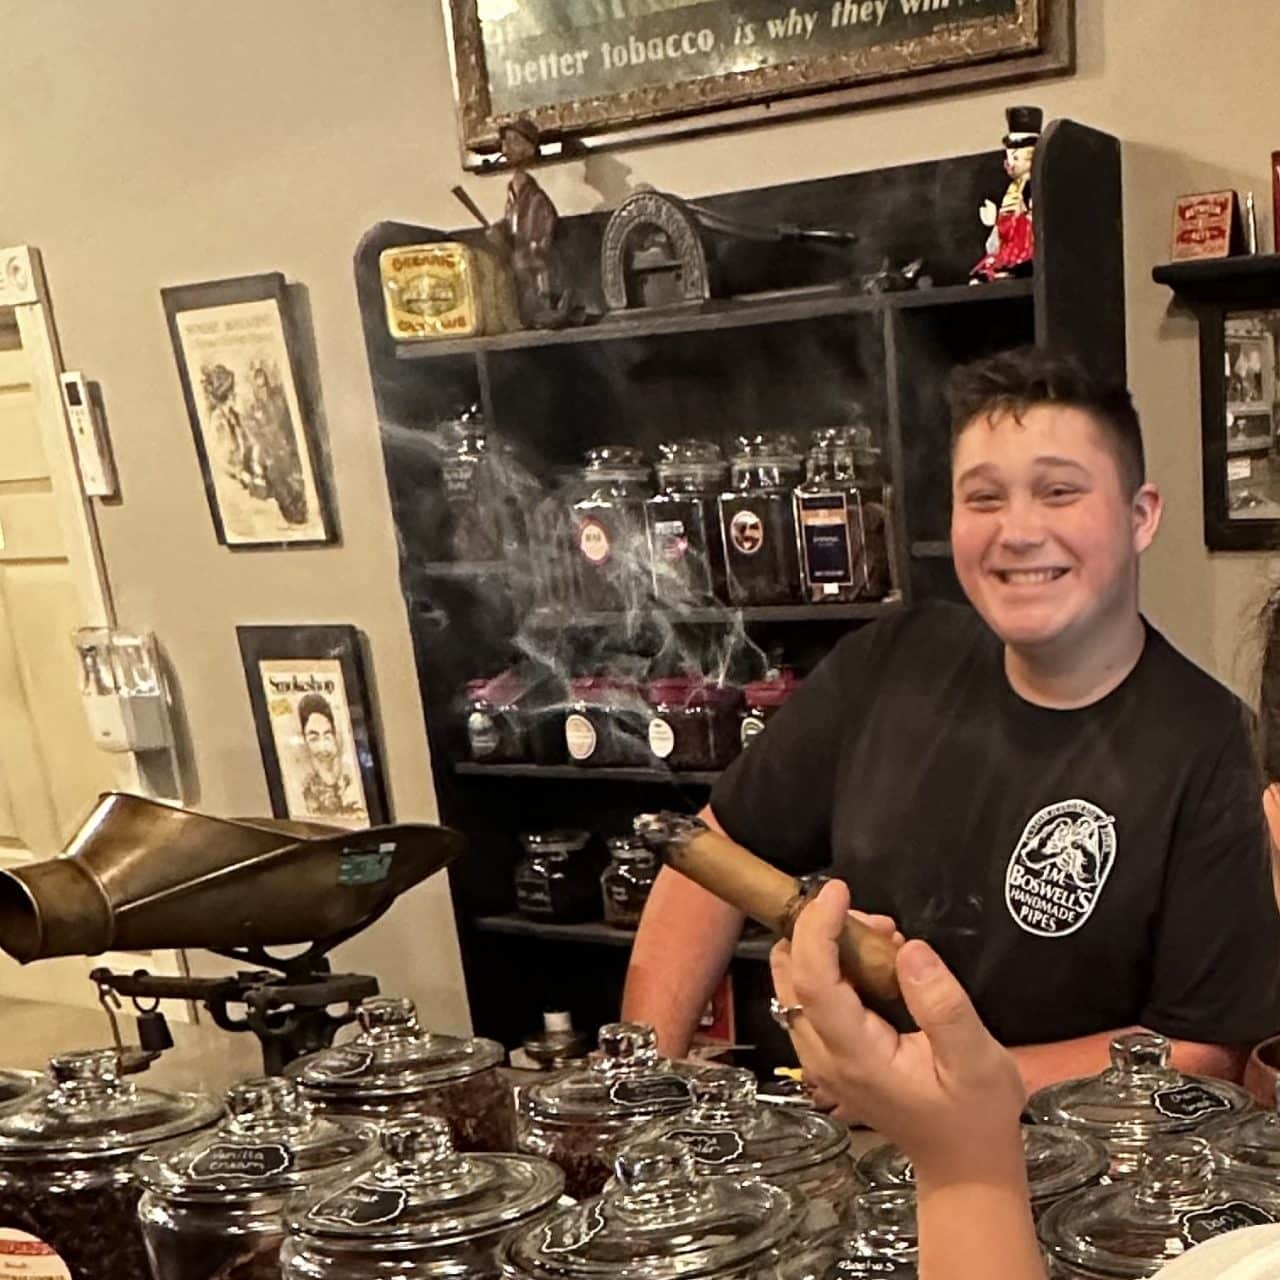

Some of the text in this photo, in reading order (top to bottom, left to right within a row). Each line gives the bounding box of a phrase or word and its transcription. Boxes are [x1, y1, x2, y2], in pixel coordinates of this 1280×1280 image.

[504, 49, 589, 88] better
[601, 28, 715, 69] tobacco
[734, 17, 756, 45] is
[767, 8, 818, 39] why
[832, 0, 888, 27] they
[1010, 863, 1093, 914] BOSWELL'S
[1010, 887, 1077, 924] HANDMADE
[1020, 906, 1057, 932] PIPES
